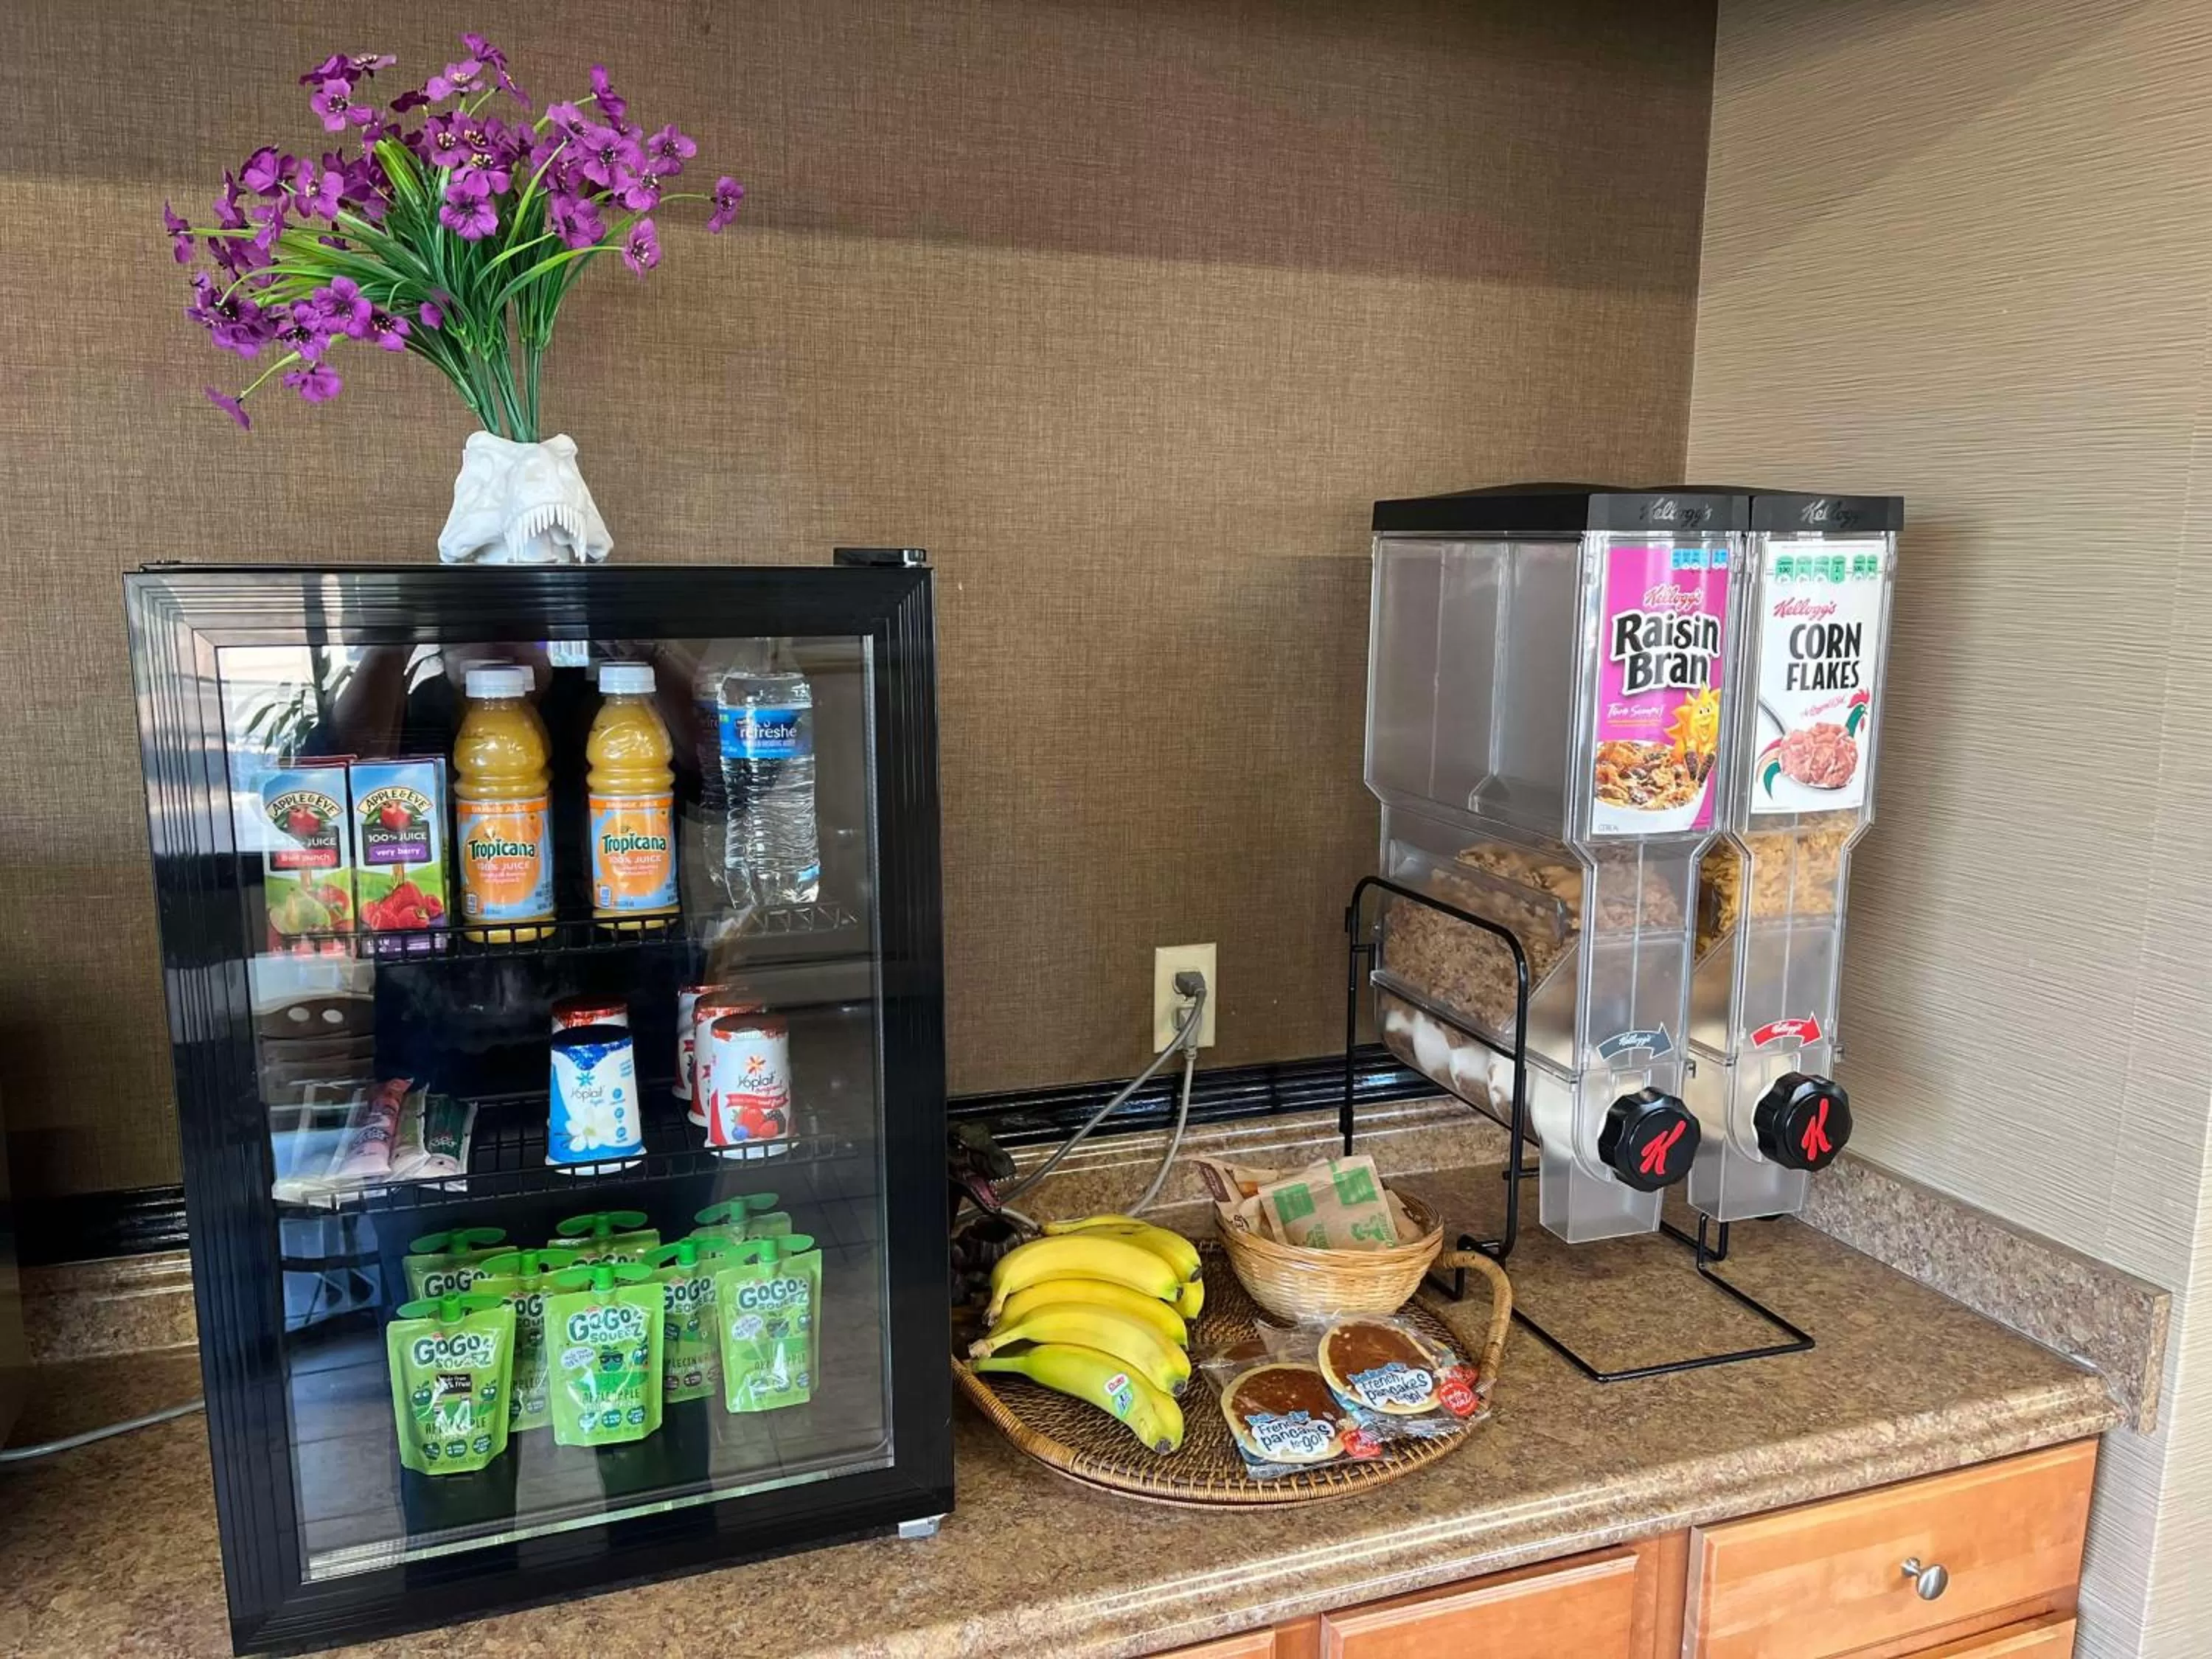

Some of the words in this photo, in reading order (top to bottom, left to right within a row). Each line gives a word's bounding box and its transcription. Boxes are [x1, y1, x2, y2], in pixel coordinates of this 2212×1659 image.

[1645, 585, 1702, 609] Kellogg's
[1773, 597, 1837, 621] Kellogg's
[1615, 613, 1719, 656] Raisin
[1790, 622, 1863, 660] CORN
[1627, 651, 1708, 691] Bran
[1786, 661, 1860, 691] FLAKES
[398, 832, 427, 841] JUICE
[602, 832, 667, 854] Tropicana
[468, 838, 535, 861] Tropicana
[634, 855, 661, 864] JUICE
[502, 861, 529, 871] JUICE
[1801, 1098, 1832, 1161] K
[1639, 1120, 1686, 1174] K
[1362, 1372, 1399, 1390] French
[1366, 1373, 1428, 1405] pancakes
